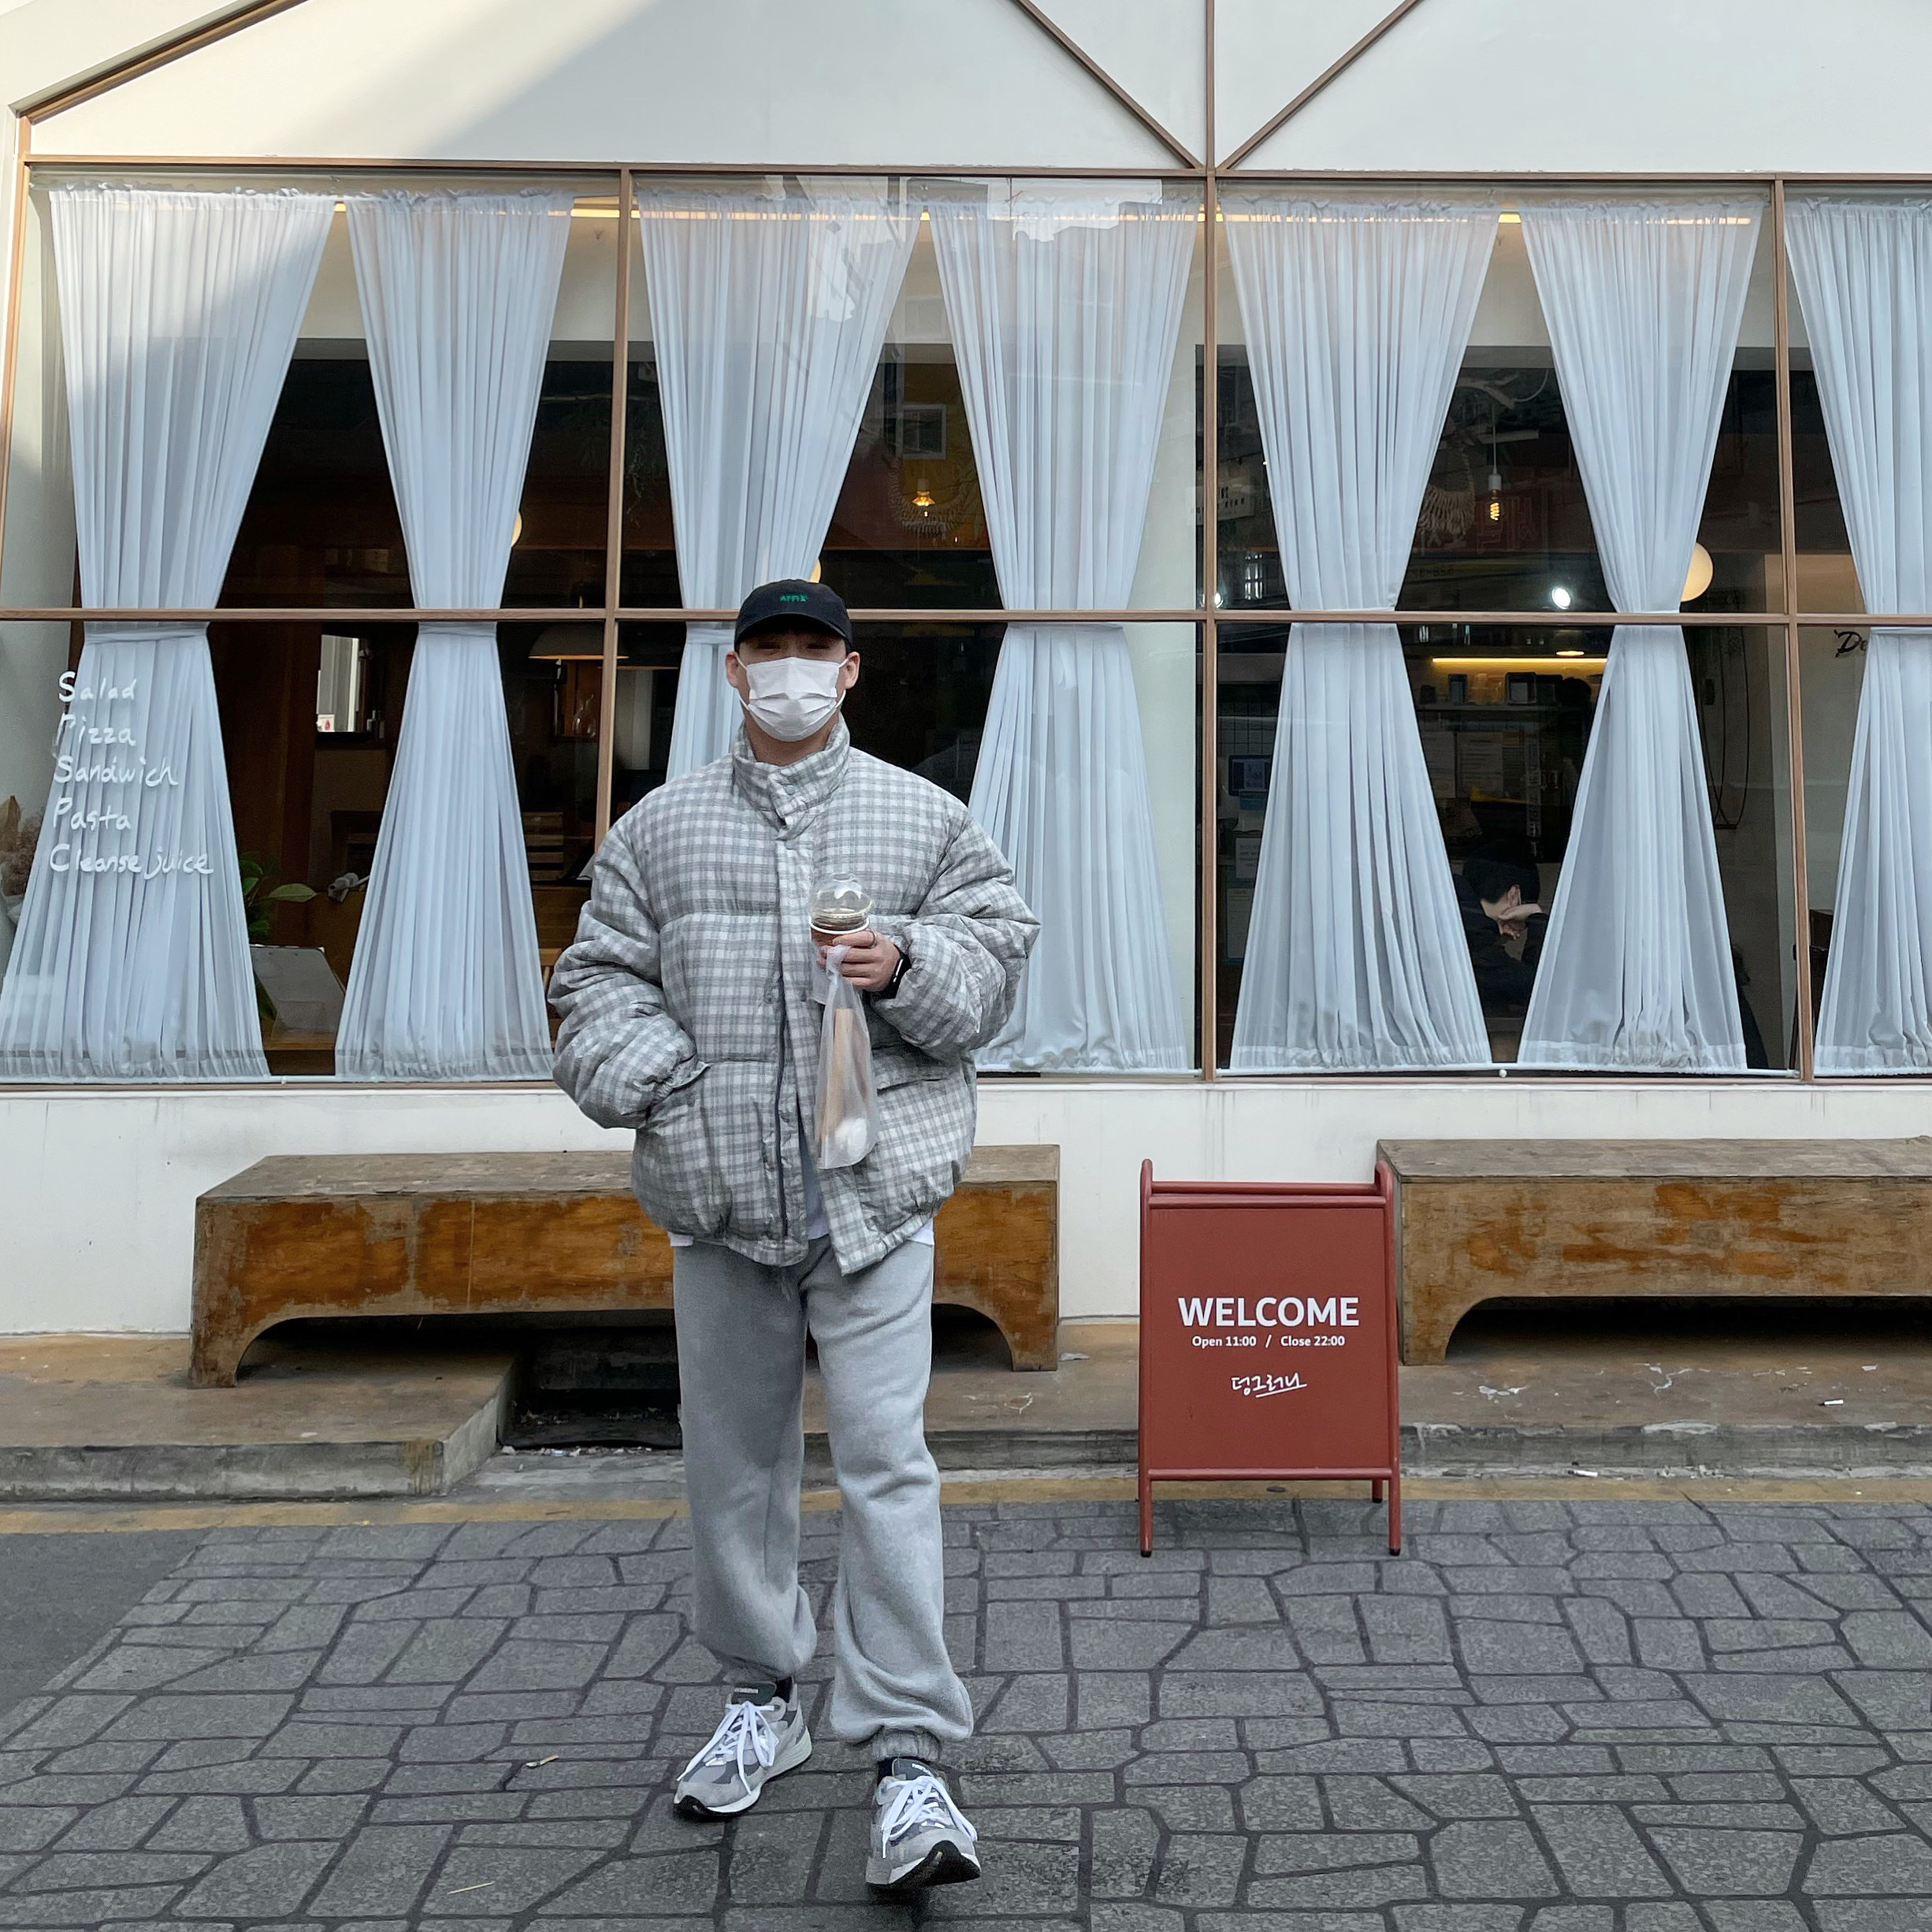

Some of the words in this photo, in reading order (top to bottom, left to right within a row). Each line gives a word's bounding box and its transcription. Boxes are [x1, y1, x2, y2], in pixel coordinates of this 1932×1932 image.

[58, 671, 136, 703] Salad
[55, 711, 137, 747] Pizza
[53, 754, 179, 787] Sandwich
[53, 797, 132, 830] Pasta
[50, 843, 143, 872] Cleanse
[143, 846, 214, 880] juice
[1178, 1297, 1359, 1327] WELCOME
[1191, 1336, 1222, 1349] Open
[1225, 1336, 1257, 1347] 11:00
[1280, 1336, 1311, 1347] Close
[1313, 1336, 1346, 1347] 22:00
[1231, 1373, 1307, 1398] 덩그러니
